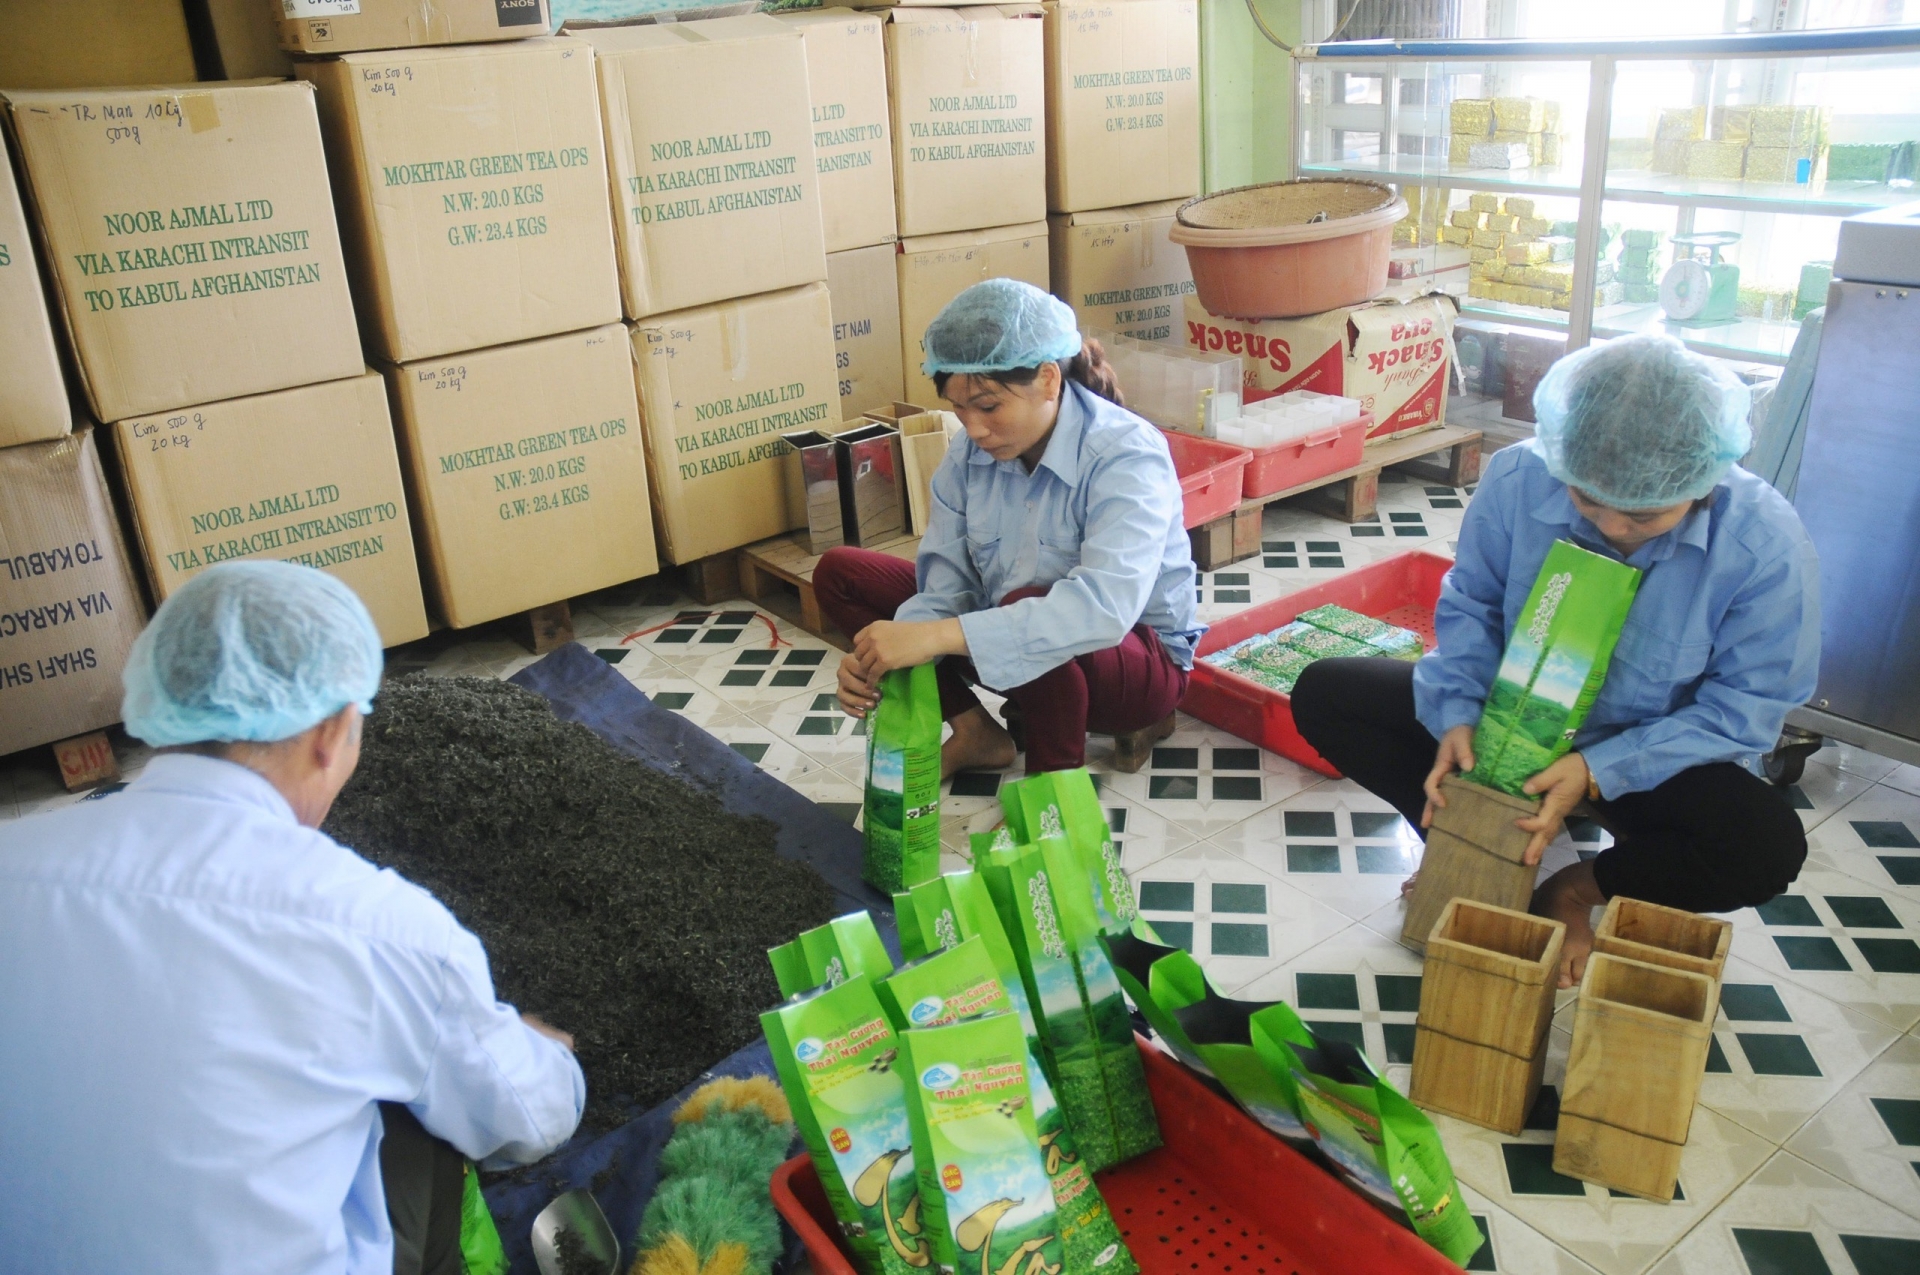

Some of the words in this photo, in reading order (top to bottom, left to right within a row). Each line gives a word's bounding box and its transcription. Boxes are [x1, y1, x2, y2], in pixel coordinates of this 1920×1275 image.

[1074, 73, 1121, 88] MOKHTAR
[1123, 70, 1154, 84] GREEN
[1156, 69, 1172, 82] TEA
[1175, 67, 1191, 80] OPS
[823, 104, 844, 121] LTD
[930, 97, 960, 112] NOOR
[963, 96, 996, 110] AJMAL
[999, 95, 1017, 109] LTD
[1106, 95, 1125, 109] N.W:
[1128, 94, 1144, 107] 20.0
[1146, 92, 1163, 105] KGS
[868, 124, 882, 139] TO
[910, 123, 929, 137] VIA
[932, 121, 979, 136] KARACHI
[982, 118, 1032, 134] INTRANSIT
[1106, 118, 1126, 132] G.W:
[1128, 117, 1144, 130] 23.4
[1146, 114, 1163, 128] KGS
[651, 141, 693, 161] NOOR
[696, 134, 742, 155] AJMAL
[744, 131, 771, 149] LTD
[911, 148, 925, 162] TO
[928, 146, 965, 161] KABUL
[966, 141, 1035, 158] AFGHANISTAN
[383, 160, 467, 186] MOKHTAR
[470, 154, 523, 177] GREEN
[527, 152, 557, 171] TEA
[560, 148, 588, 167] OPS
[628, 176, 654, 195] VIA
[657, 167, 721, 191] KARACHI
[724, 157, 796, 181] INTRANSIT
[443, 192, 478, 213] N.W:
[482, 189, 509, 209] 20.0
[513, 184, 543, 205] KGS
[632, 206, 651, 224] TO
[655, 199, 704, 221] KABUL
[708, 185, 801, 214] AFGHANISTAN
[104, 211, 164, 236] NOOR
[169, 204, 233, 229] AJMAL
[235, 200, 273, 222] LTD
[448, 225, 482, 245] G.W:
[485, 222, 513, 241] 23.4
[516, 216, 547, 237] KGS
[74, 253, 114, 276] VIA
[116, 242, 207, 271] KARACHI
[209, 230, 309, 260] INTRANSIT
[85, 290, 114, 311] TO
[117, 281, 187, 308] KABUL
[191, 263, 320, 298] AFGHANISTAN
[1084, 290, 1131, 306] MOKHTAR
[1133, 286, 1161, 300] GREEN
[1164, 284, 1179, 296] TEA
[1181, 280, 1195, 293] OPS
[850, 319, 871, 337] NAM
[1116, 311, 1135, 324] N.W:
[1137, 309, 1153, 321] 20.0
[1154, 305, 1170, 319] KGS
[1136, 330, 1152, 340] 23.4
[1153, 325, 1170, 339] KGS
[1188, 321, 1291, 372] Snack
[1368, 338, 1444, 375] Snack
[419, 370, 435, 382] Kim
[695, 399, 733, 421] NOOR
[736, 389, 778, 412] AJMAL
[780, 383, 804, 401] LTD
[133, 423, 159, 438] Kim
[675, 435, 699, 453] VIA
[700, 420, 759, 446] KARACHI
[762, 403, 828, 433] INTRANSIT
[439, 443, 515, 473] MOKHTAR
[518, 431, 566, 456] GREEN
[570, 425, 597, 445] TEA
[600, 419, 627, 438] OPS
[494, 470, 527, 492] N.W:
[530, 464, 555, 483] 20.0
[557, 456, 586, 477] KGS
[679, 462, 697, 480] TO
[700, 451, 745, 475] KABUL
[191, 507, 245, 534] NOOR
[248, 493, 305, 521] AJMAL
[306, 484, 340, 508] LTD
[499, 499, 530, 520] G.W:
[534, 493, 558, 512] 23.4
[561, 484, 589, 505] KGS
[75, 539, 103, 564] TO
[167, 552, 202, 572] VIA
[202, 529, 282, 564] KARACHI
[285, 509, 372, 544] INTRANSIT
[375, 502, 397, 519] TO
[0, 546, 74, 580] KABUL
[78, 592, 112, 617] VIA
[38, 648, 97, 679] SHAFI
